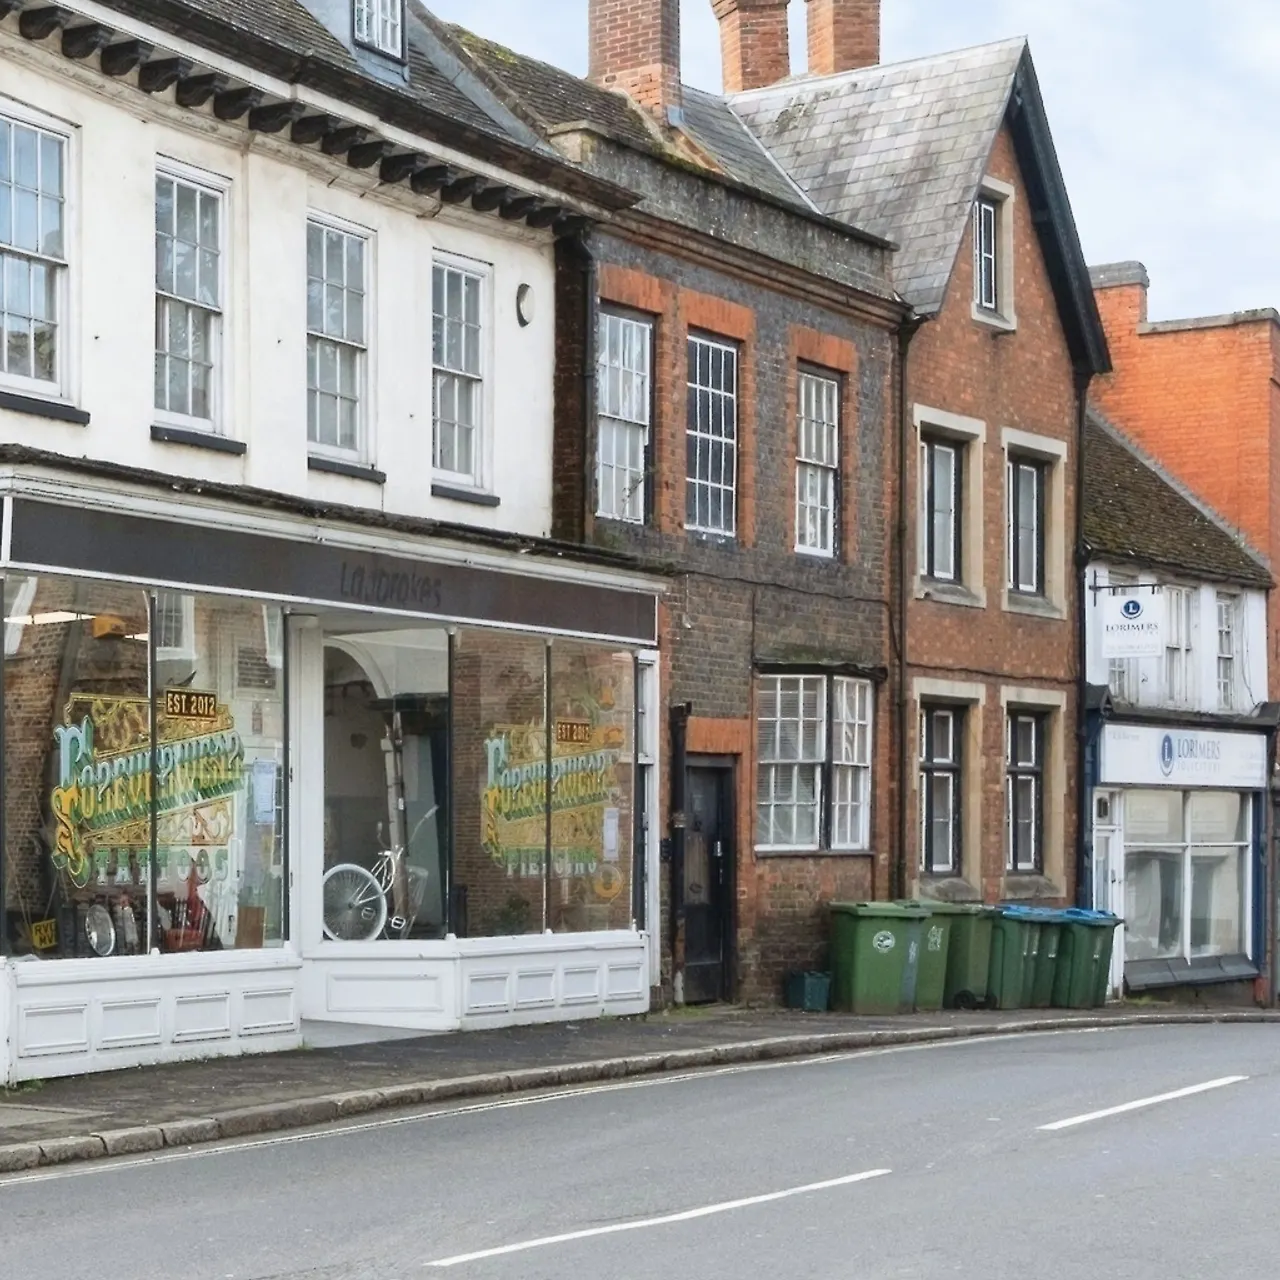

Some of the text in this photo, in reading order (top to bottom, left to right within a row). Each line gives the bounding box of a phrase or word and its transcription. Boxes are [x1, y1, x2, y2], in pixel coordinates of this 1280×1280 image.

[1106, 623, 1158, 632] LORIMERS
[190, 695, 216, 716] 2012
[1177, 737, 1221, 760] LORIMERS
[94, 848, 229, 885] TATTOOS
